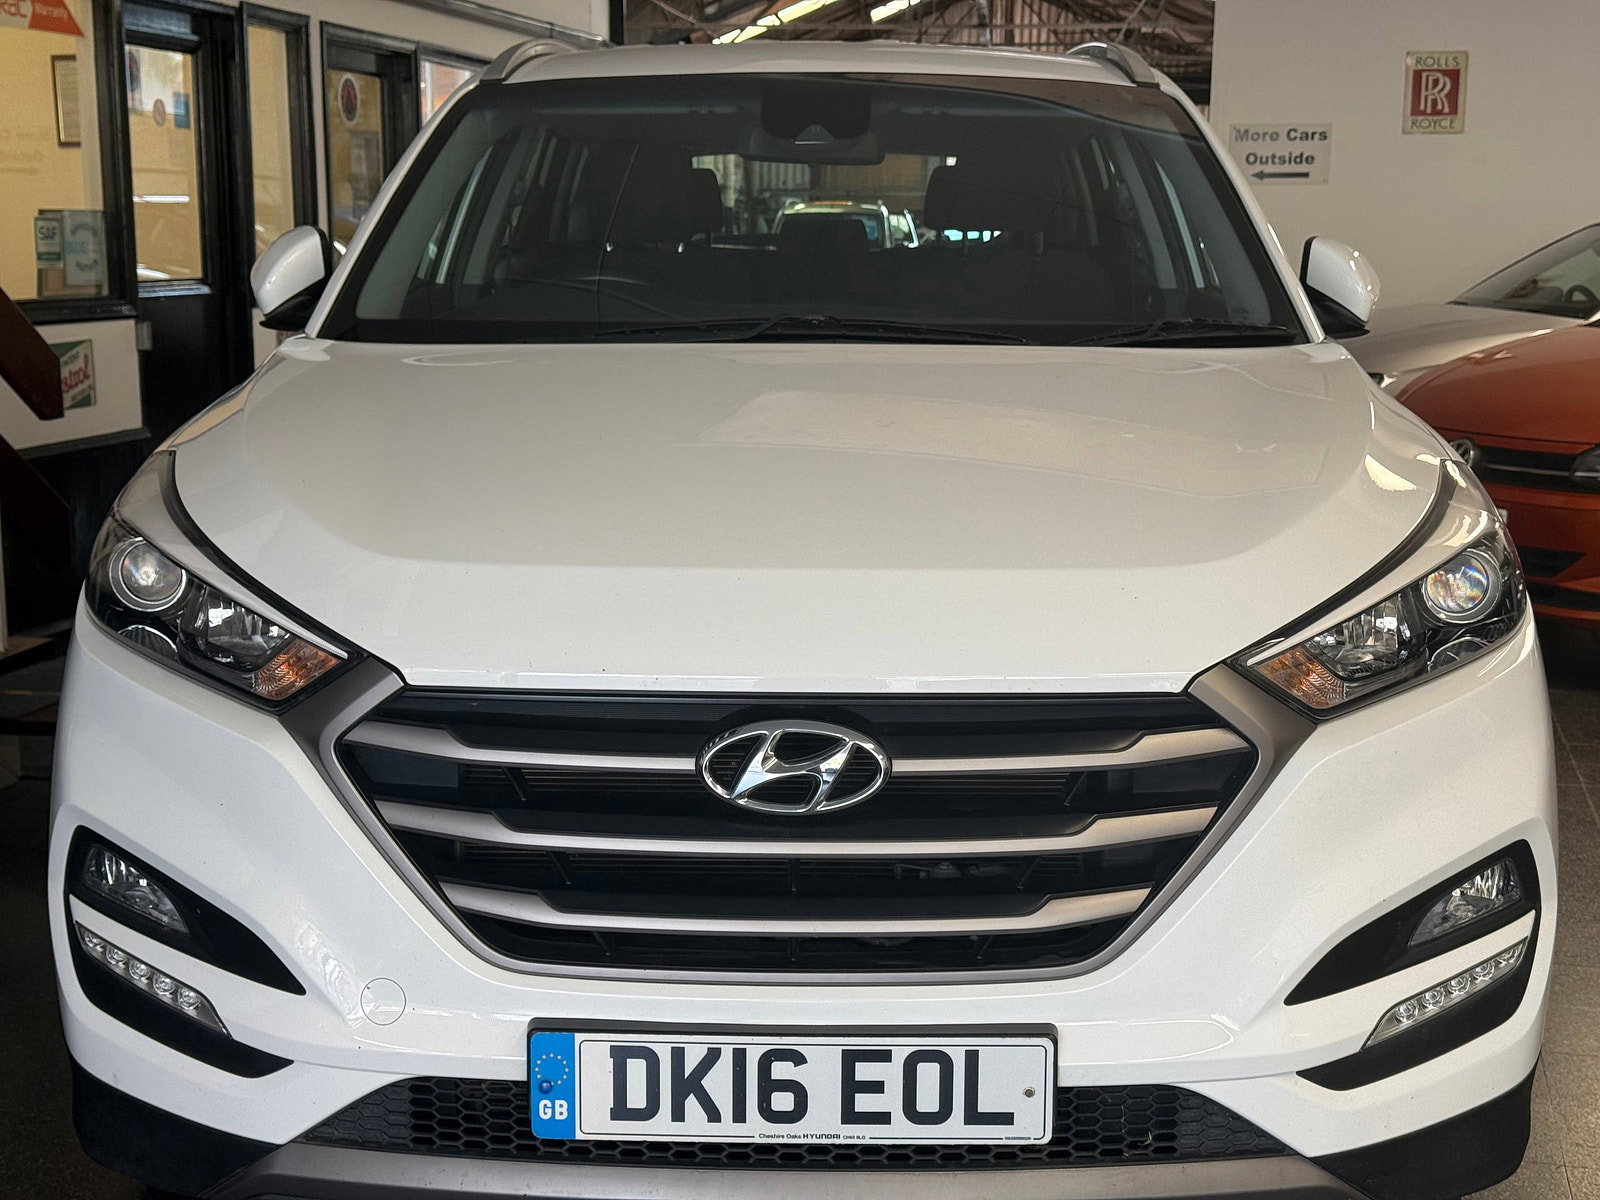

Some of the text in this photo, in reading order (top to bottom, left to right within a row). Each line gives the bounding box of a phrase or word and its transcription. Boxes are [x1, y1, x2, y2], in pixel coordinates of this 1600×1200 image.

[1415, 56, 1460, 68] ROLLS
[1410, 118, 1456, 130] ROYCE
[1234, 128, 1328, 142] More Cars
[1245, 152, 1315, 166] Outside
[610, 1045, 1015, 1126] DK16 EOL
[538, 1099, 569, 1120] GB
